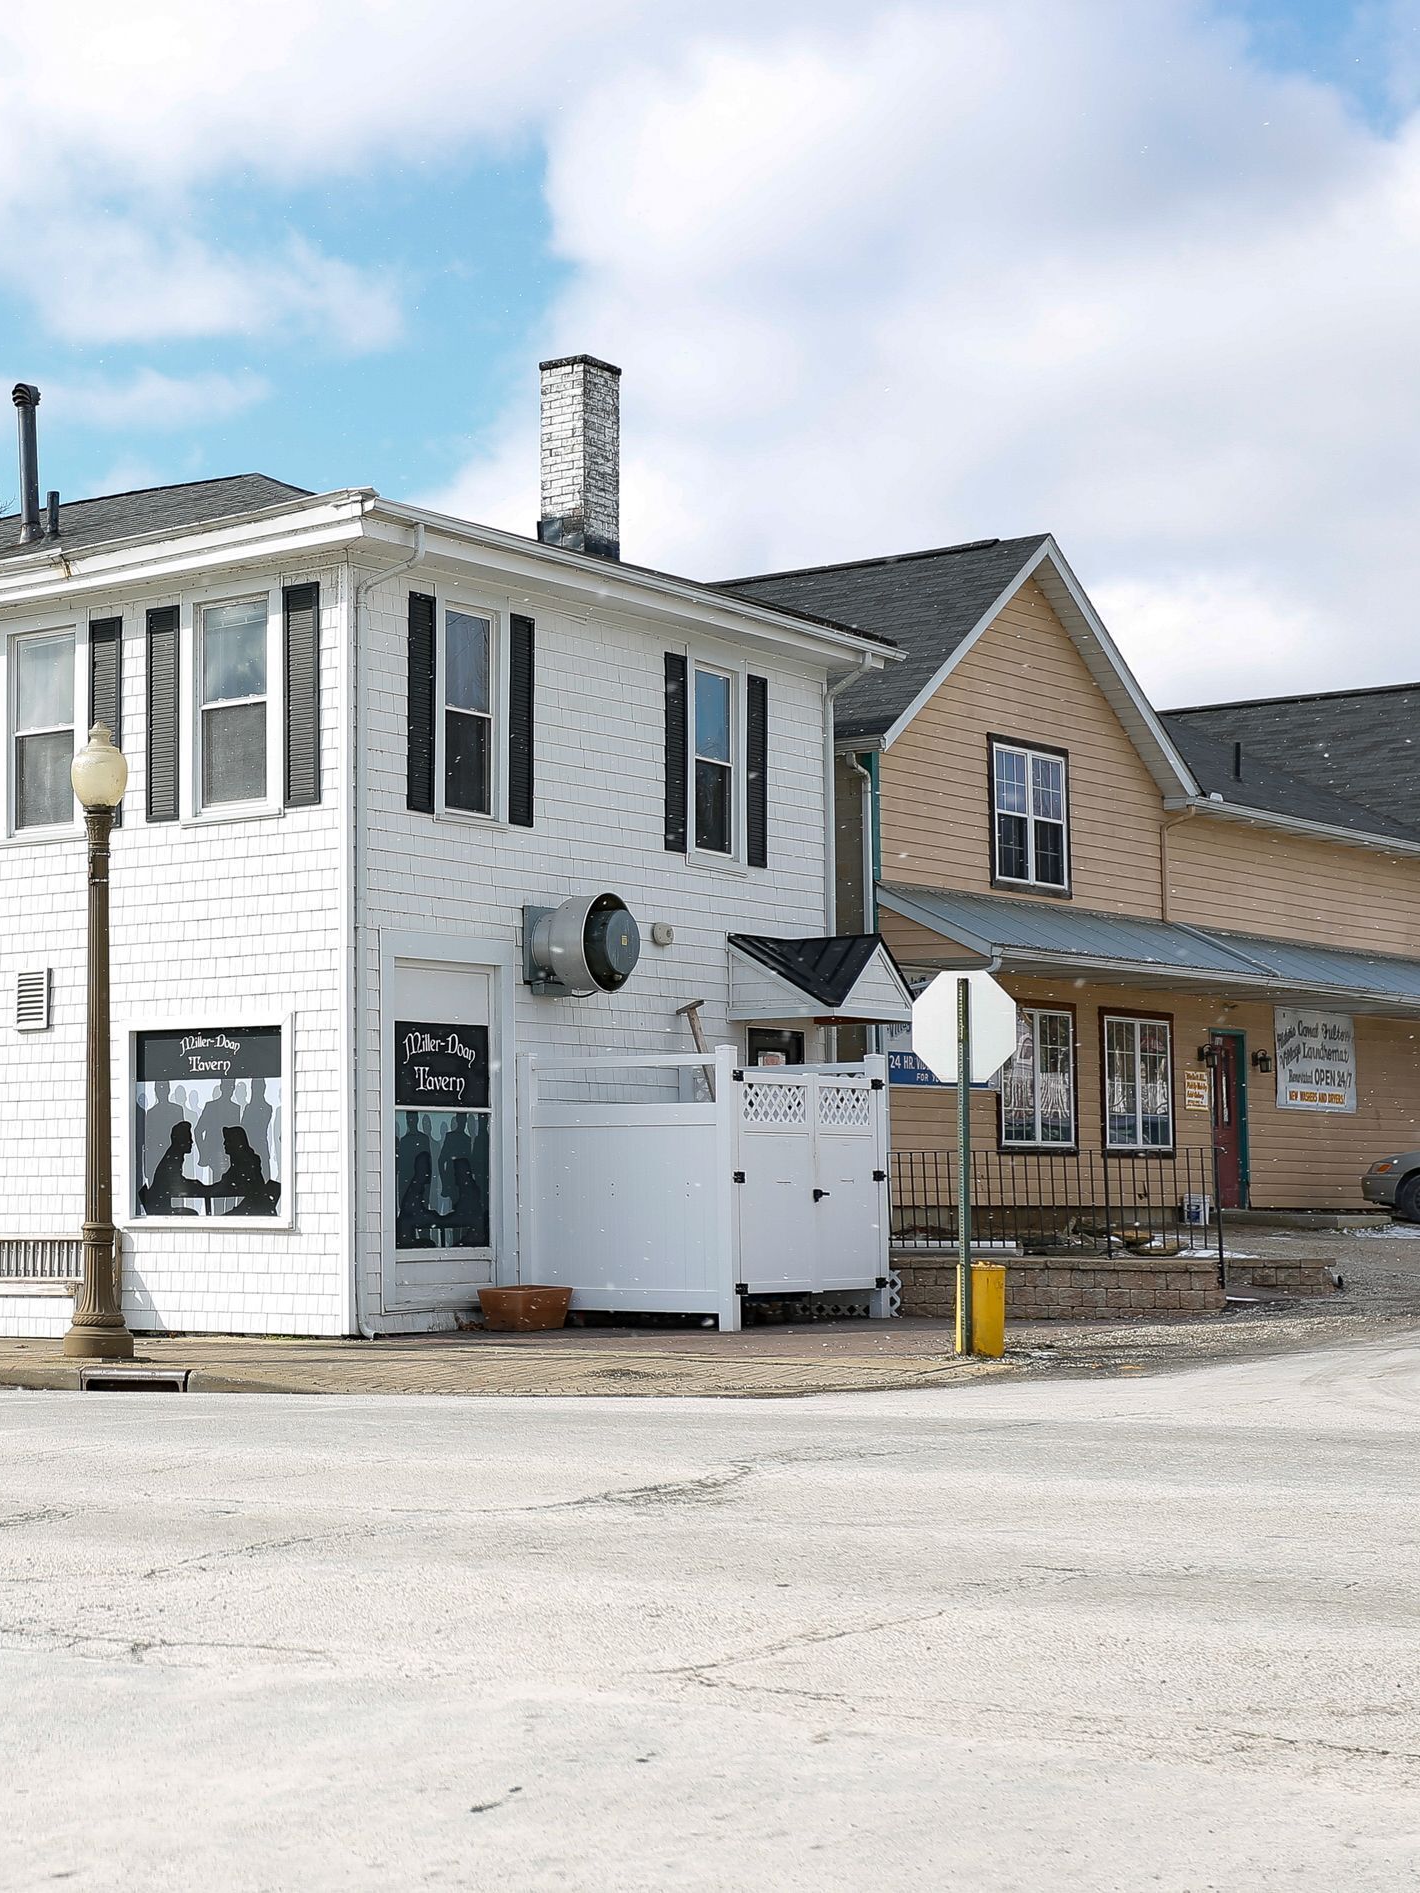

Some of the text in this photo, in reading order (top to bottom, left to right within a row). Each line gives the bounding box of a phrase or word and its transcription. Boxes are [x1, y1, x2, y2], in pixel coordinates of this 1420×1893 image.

[1297, 1020, 1319, 1038] Canal
[179, 1034, 241, 1057] Miller-Doan
[402, 1032, 476, 1069] Miller-Doan
[188, 1056, 231, 1076] Tavern
[889, 1055, 901, 1069] 24
[413, 1066, 466, 1100] Tavern
[916, 1072, 929, 1082] FOR
[1314, 1068, 1336, 1087] OPEN
[1337, 1069, 1353, 1089] 24/7
[1318, 1092, 1328, 1103] AND
